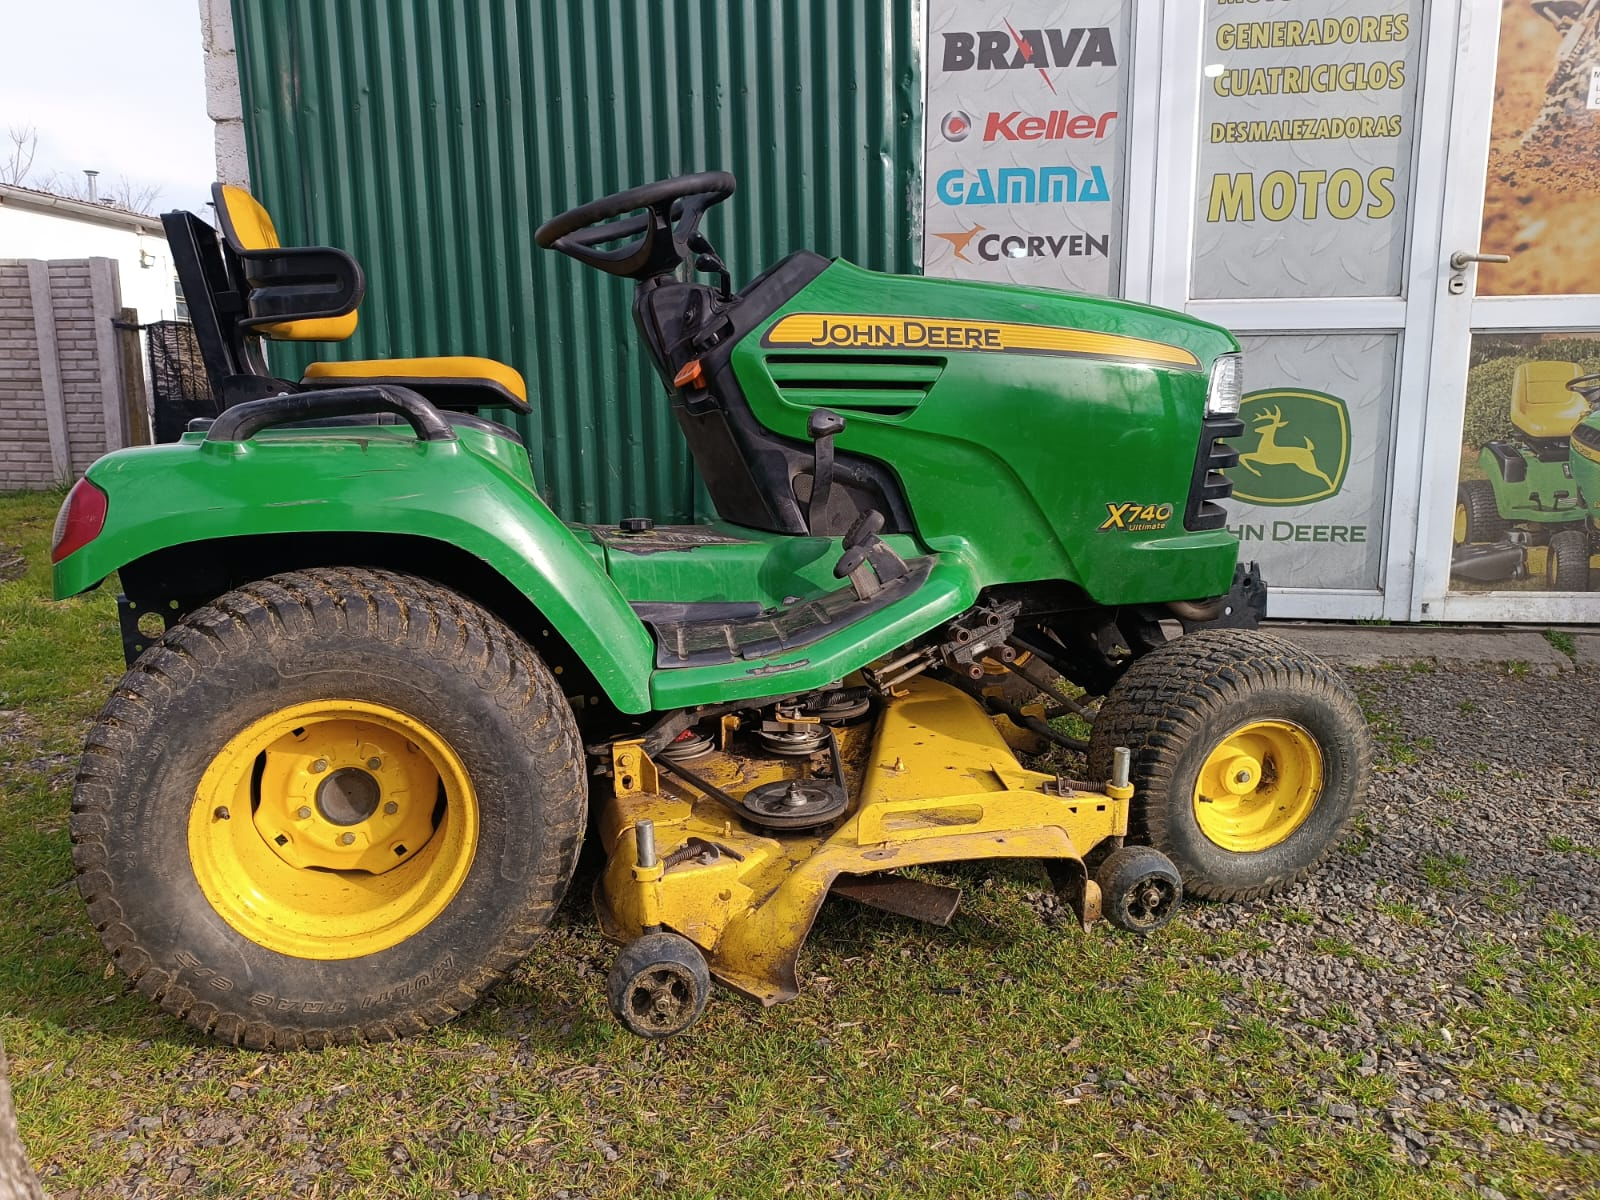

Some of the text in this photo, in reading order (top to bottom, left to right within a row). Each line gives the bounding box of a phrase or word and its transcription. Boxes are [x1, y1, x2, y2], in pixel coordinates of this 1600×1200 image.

[1216, 14, 1409, 50] GENERADORES
[942, 27, 1117, 72] BRAVA
[1213, 60, 1406, 97] CUATRICICLOS
[983, 110, 1118, 141] Keller
[1211, 115, 1402, 143] DESMALEZADORAS
[936, 166, 1111, 206] GAMMA
[1207, 166, 1396, 222] MOTOS
[977, 232, 1109, 262] CORVEN
[811, 320, 1001, 347] JOHN DEERE
[1100, 503, 1172, 529] X740
[1128, 523, 1167, 532] Ultimate
[1272, 520, 1367, 542] DEERE
[360, 954, 455, 1010] MULTI
[251, 993, 348, 1014] TRAC
